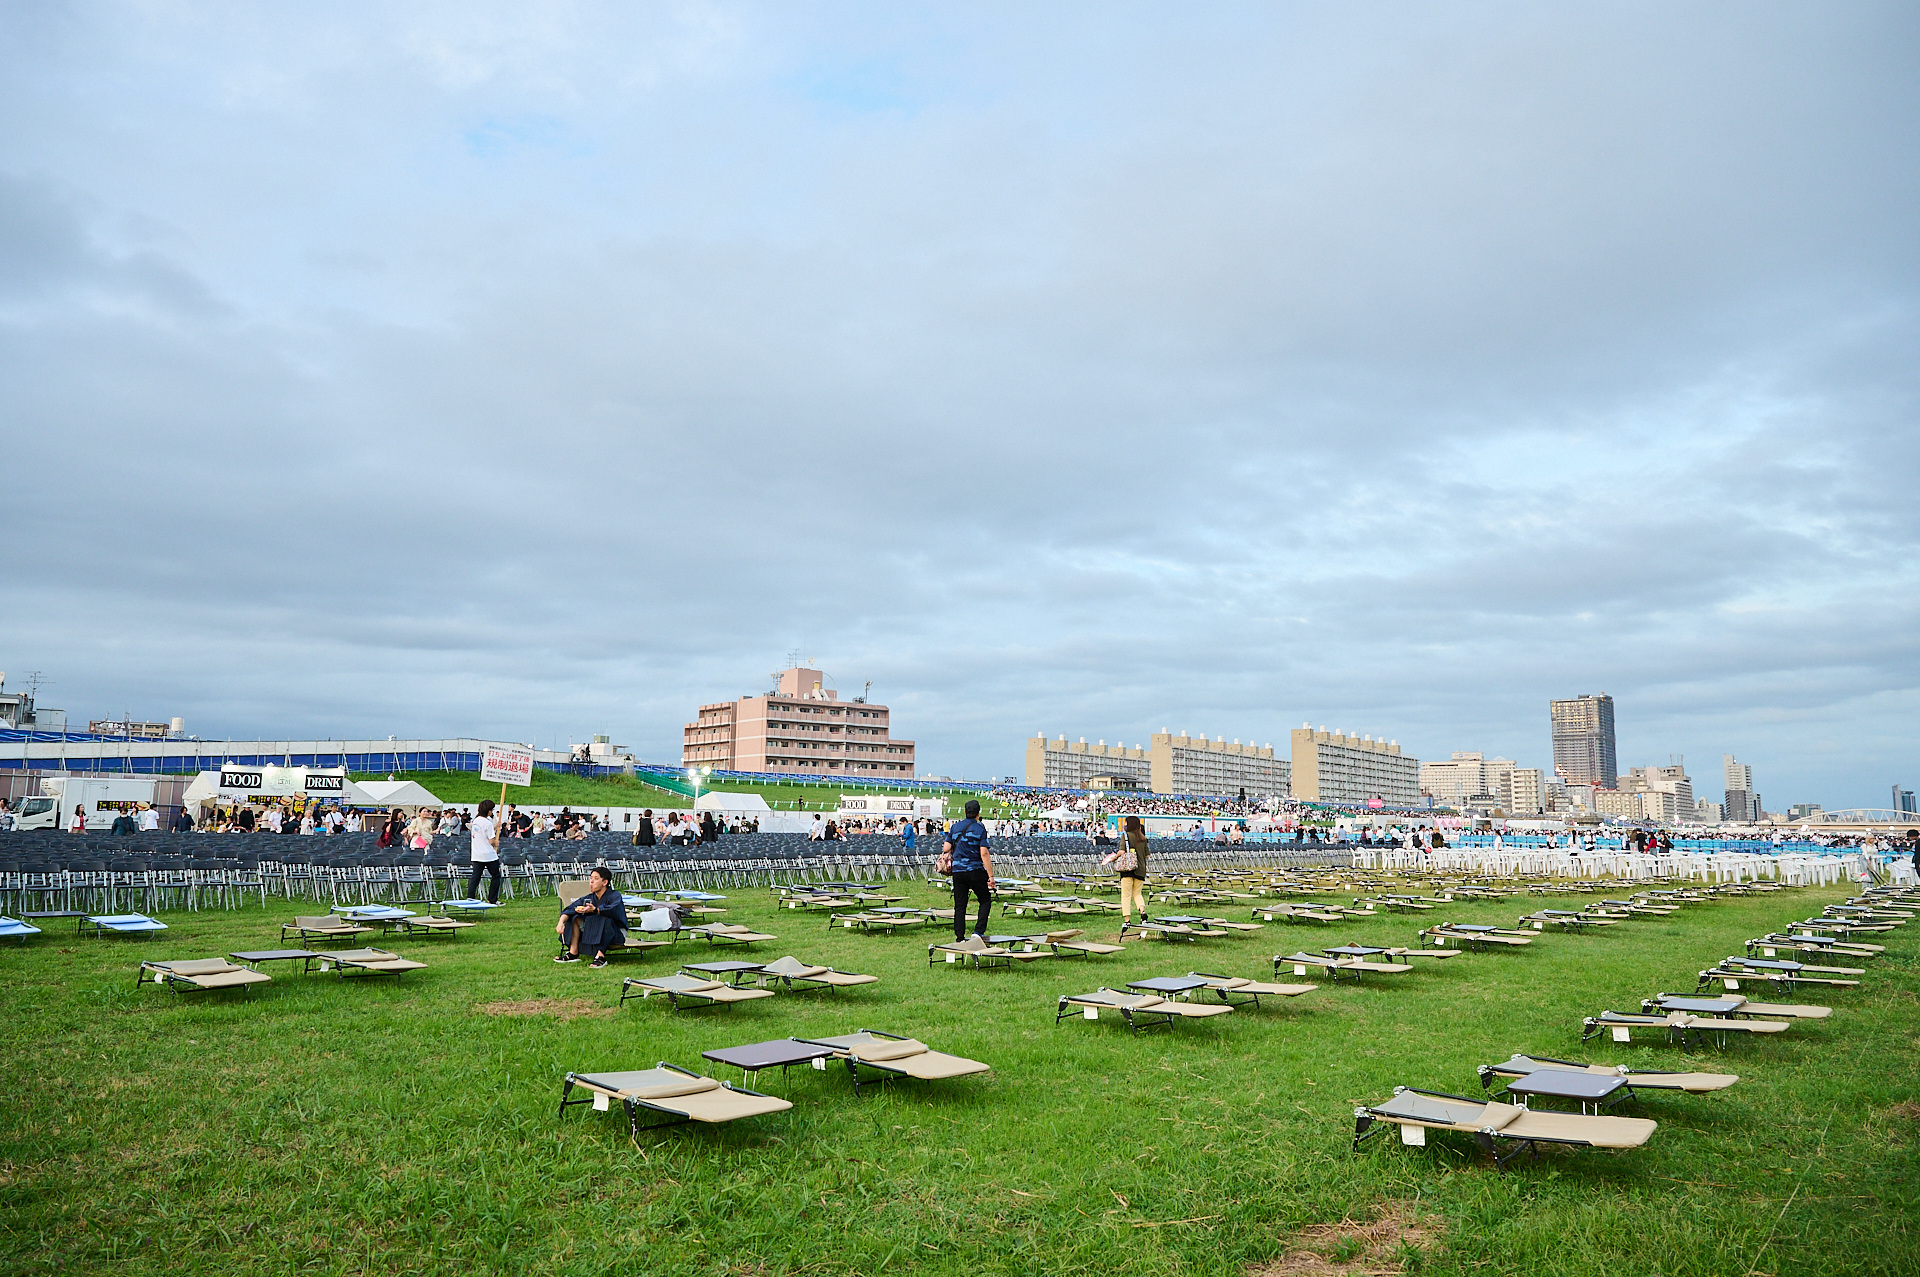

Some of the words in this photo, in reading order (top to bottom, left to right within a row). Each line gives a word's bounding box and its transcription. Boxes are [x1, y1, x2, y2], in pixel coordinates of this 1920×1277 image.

[488, 750, 530, 763] 打ち上げ終了後
[486, 758, 529, 774] 規制退場
[224, 773, 261, 787] FOOD
[306, 777, 341, 788] DRINK
[845, 800, 865, 809] FOOD
[890, 801, 911, 810] DRINK
